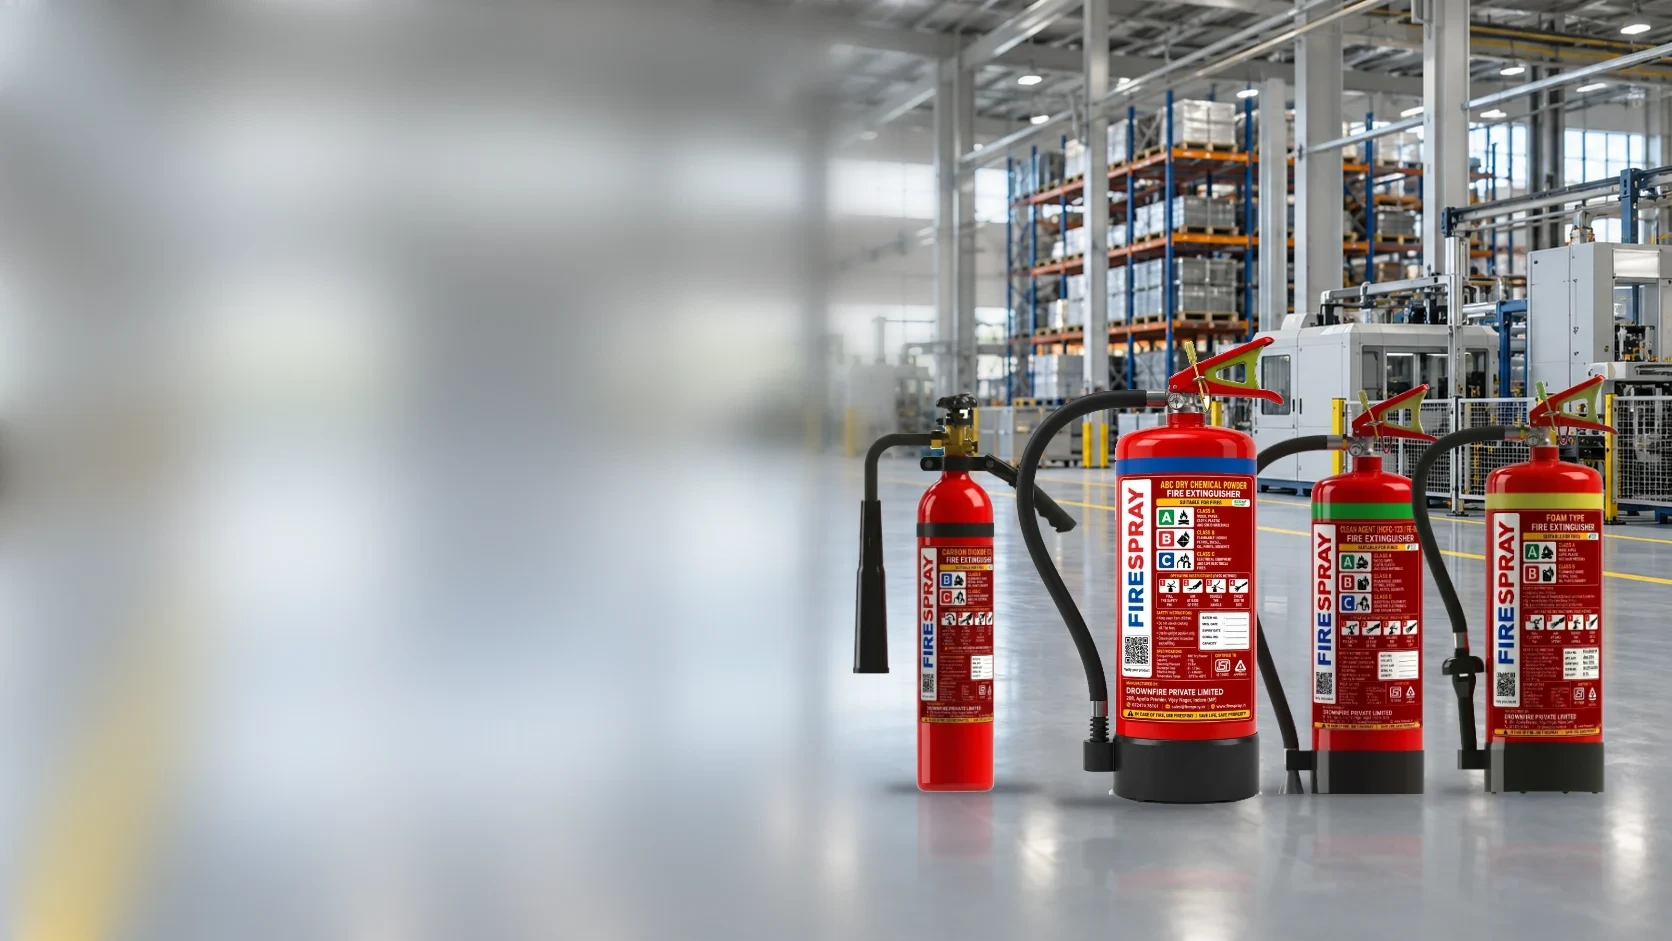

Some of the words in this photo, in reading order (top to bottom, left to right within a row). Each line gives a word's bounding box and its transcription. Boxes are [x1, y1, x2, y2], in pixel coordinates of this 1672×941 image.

[1160, 481, 1174, 489] ABC
[1176, 481, 1188, 489] DRY
[1190, 481, 1221, 489] CHEMICAL
[1223, 481, 1247, 489] POWDER
[1162, 512, 1172, 522] A
[1546, 514, 1567, 522] FOAM
[1569, 514, 1584, 522] TYPE
[1162, 534, 1171, 544] B
[1528, 546, 1537, 558] A
[1128, 487, 1144, 628] FIRESPRAY
[1162, 555, 1171, 566] C
[1344, 557, 1352, 567] A
[1528, 568, 1536, 579] B
[944, 576, 950, 584] B
[1344, 578, 1352, 588] B
[943, 591, 950, 602] C
[1498, 521, 1514, 664] FIRESPRAY
[1318, 532, 1331, 666] FIRESPRAY
[1344, 598, 1352, 608] C
[924, 554, 933, 668] FIRESPRAY
[1126, 687, 1167, 695] DROWNFIRE
